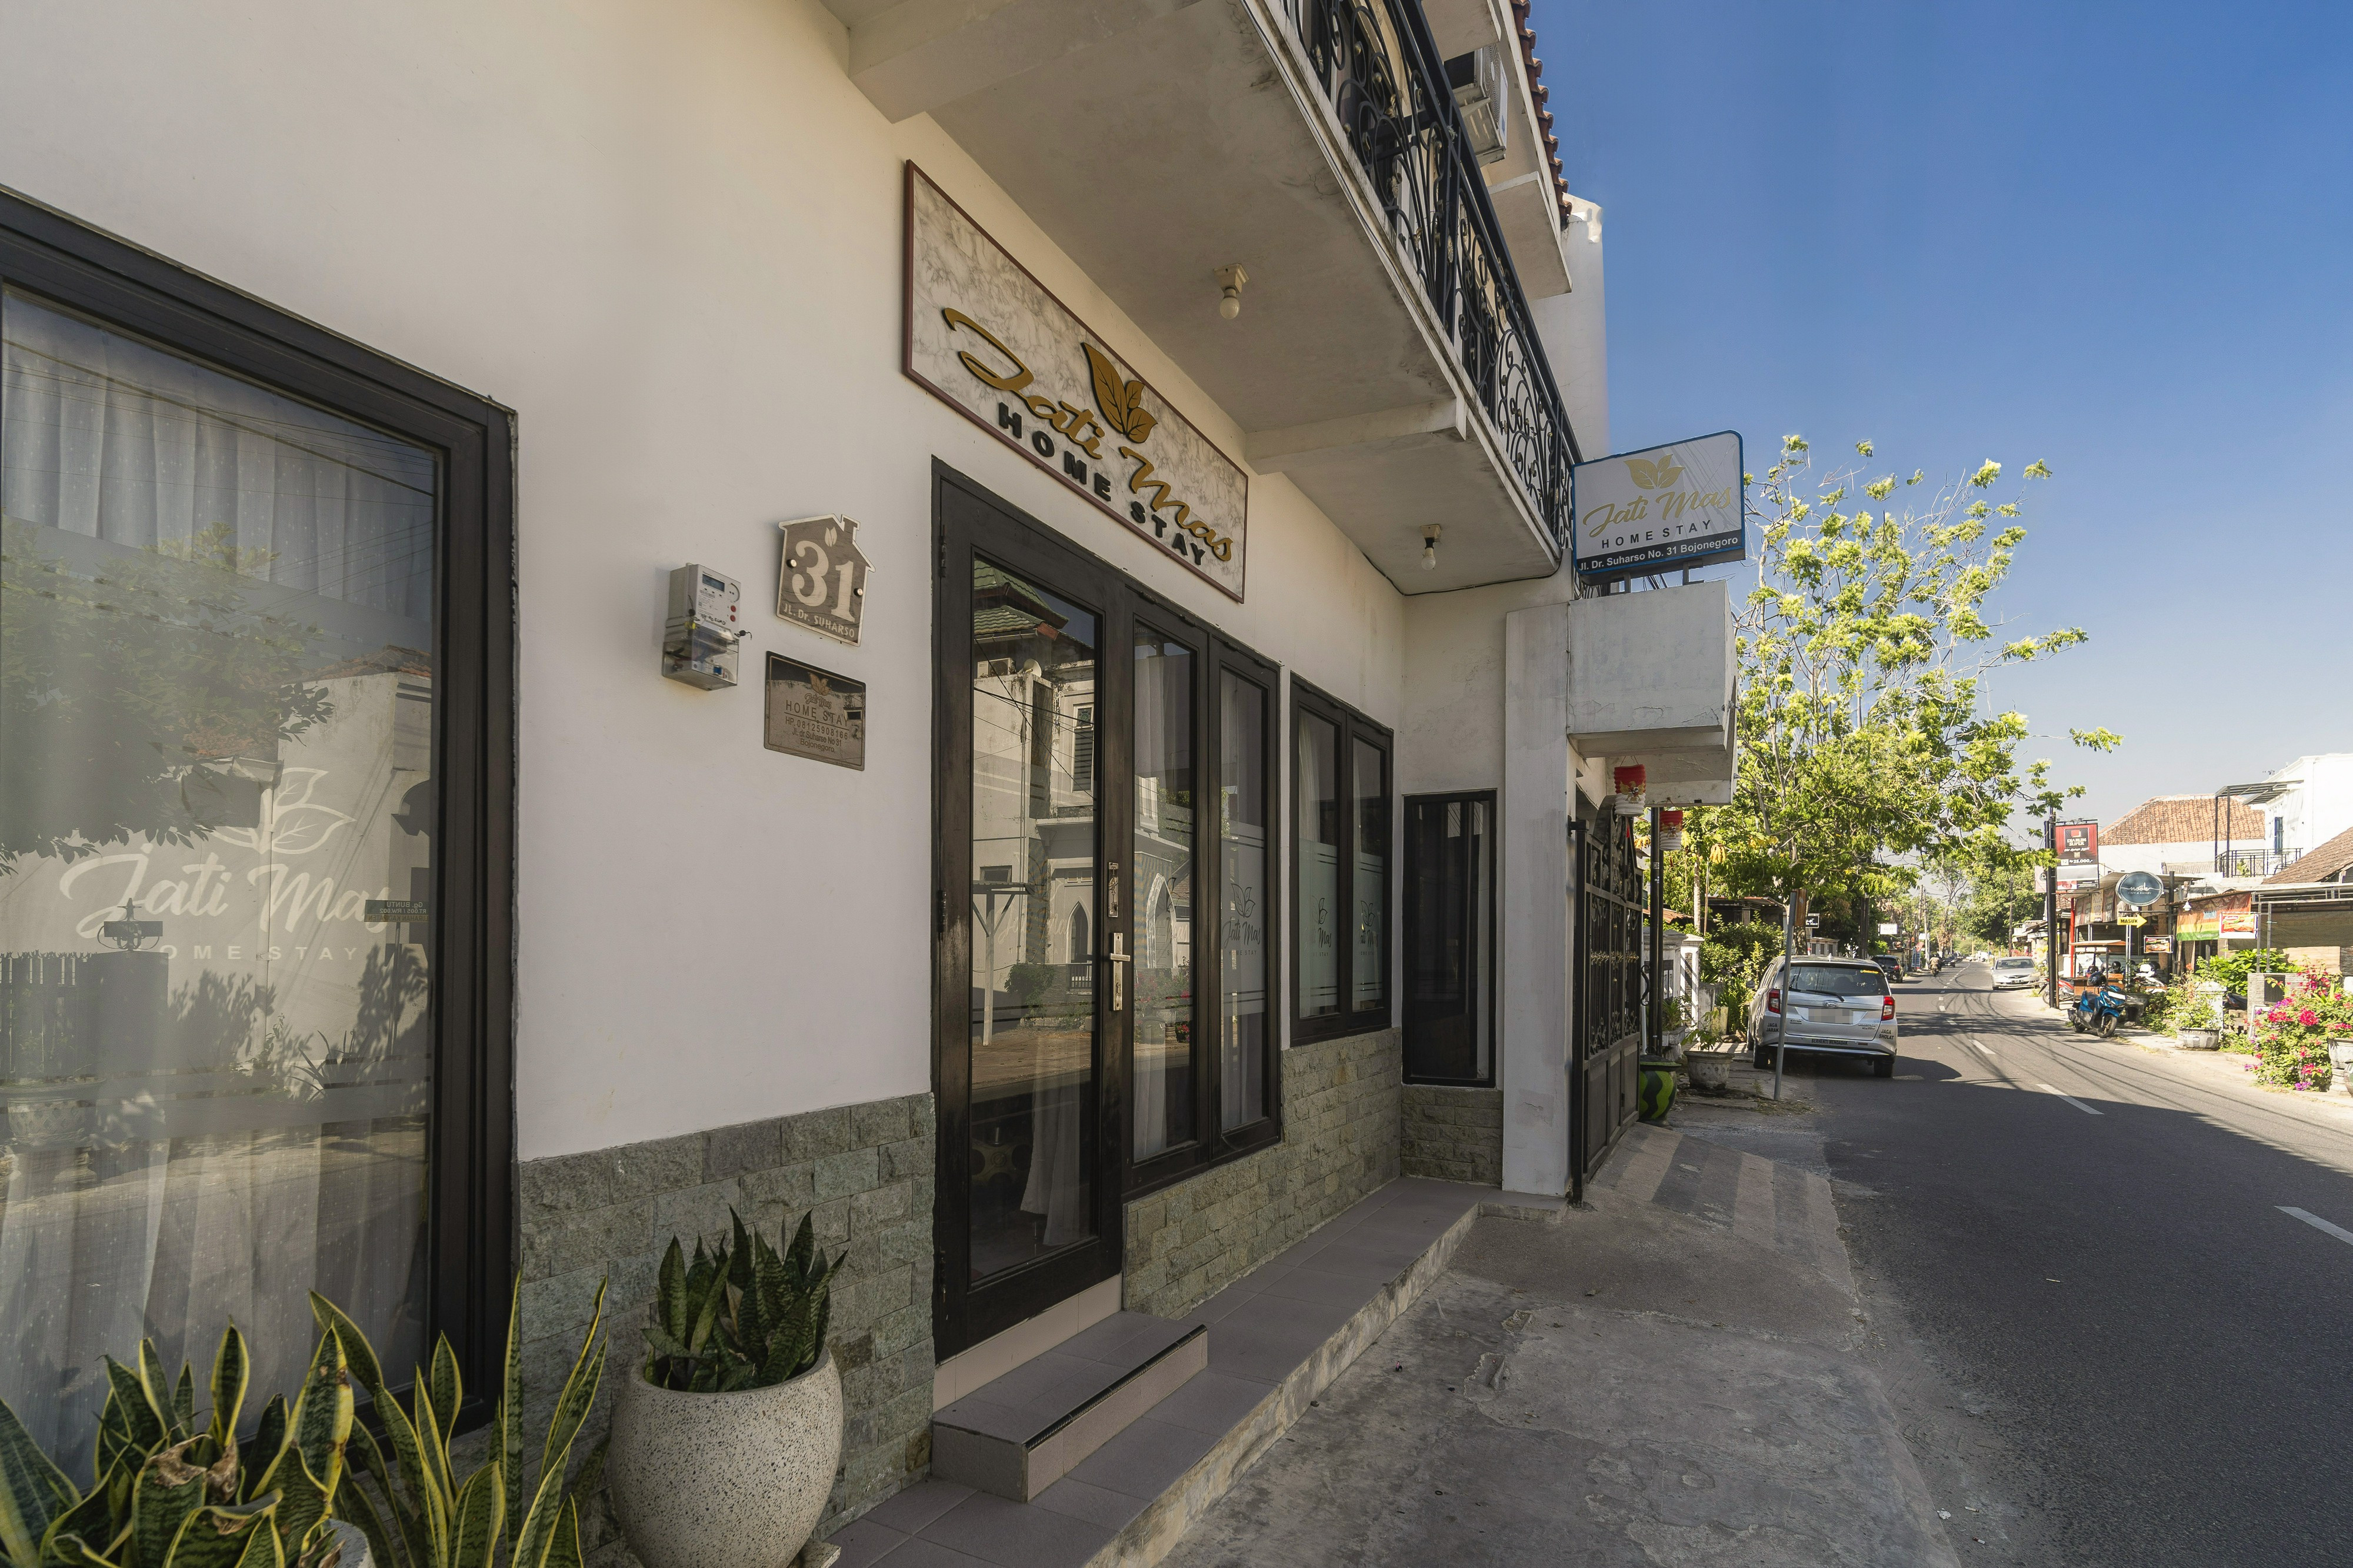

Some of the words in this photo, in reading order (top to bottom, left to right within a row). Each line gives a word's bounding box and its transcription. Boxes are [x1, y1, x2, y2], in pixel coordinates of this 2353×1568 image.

[942, 308, 1104, 460] Jati
[1119, 446, 1234, 562] Mas
[998, 402, 1111, 502] HOME
[1130, 501, 1206, 566] STAY
[1582, 495, 1648, 538] Jati
[1655, 487, 1731, 521] Mas
[1601, 531, 1654, 549] HOME
[1662, 519, 1711, 538] STAY
[1579, 562, 1589, 571] Jl.
[1591, 560, 1605, 569] Dr.
[1607, 553, 1645, 566] Suharso
[1648, 549, 1664, 559] No.
[1666, 547, 1677, 555] 31
[1680, 536, 1738, 553] Bojonegoro
[791, 540, 855, 622] 31
[784, 603, 796, 616] JL.
[798, 609, 810, 622] Dr.
[814, 615, 855, 638] SUHARSO
[785, 699, 817, 719] HOME
[822, 710, 848, 727] STAY
[800, 738, 835, 753] Bojonegoro
[805, 730, 827, 743] Suharso
[828, 737, 835, 745] No
[835, 738, 842, 747] 31
[59, 843, 232, 939] Jati
[1222, 916, 1241, 949] Jati
[1242, 920, 1261, 946] Mas
[1318, 927, 1332, 948] Mas
[159, 944, 242, 960] OME
[268, 946, 358, 962] STAY
